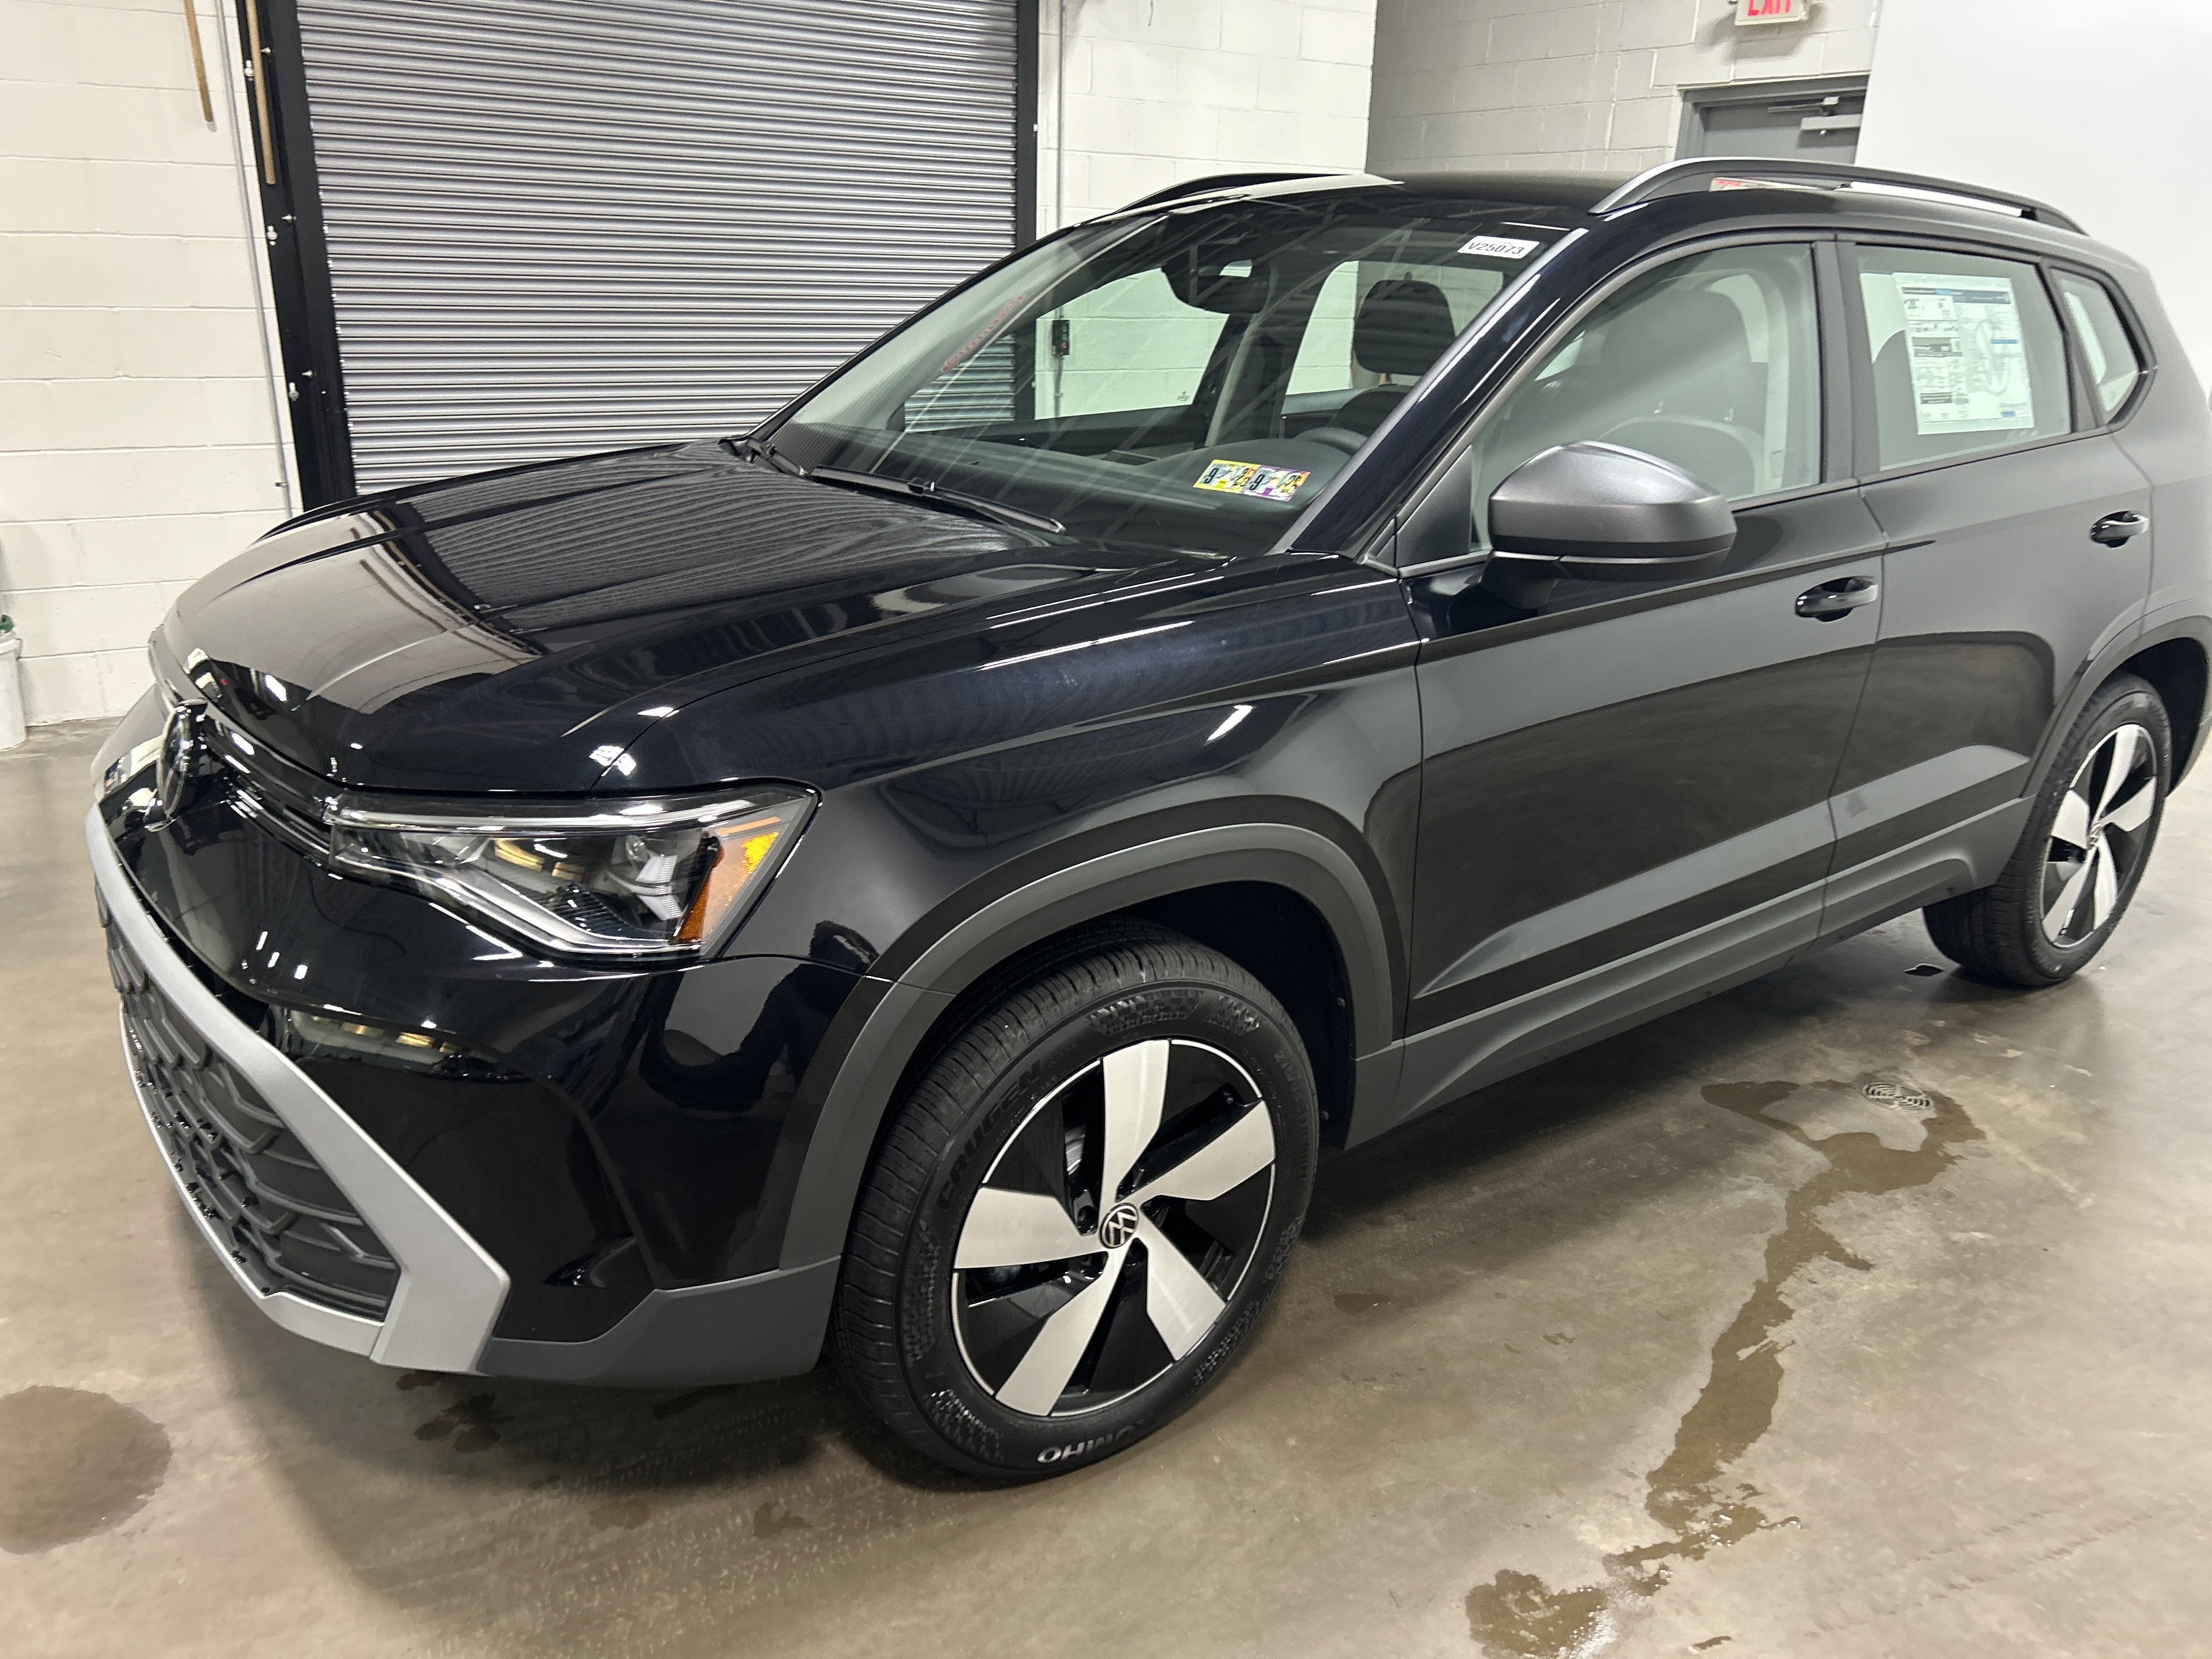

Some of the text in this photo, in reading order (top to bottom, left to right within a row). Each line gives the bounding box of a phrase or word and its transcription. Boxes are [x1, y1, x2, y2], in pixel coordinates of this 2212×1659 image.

[1468, 242, 1525, 255] V25073
[937, 1060, 1040, 1210] CRUGEN
[1036, 1418, 1145, 1464] UMHO
